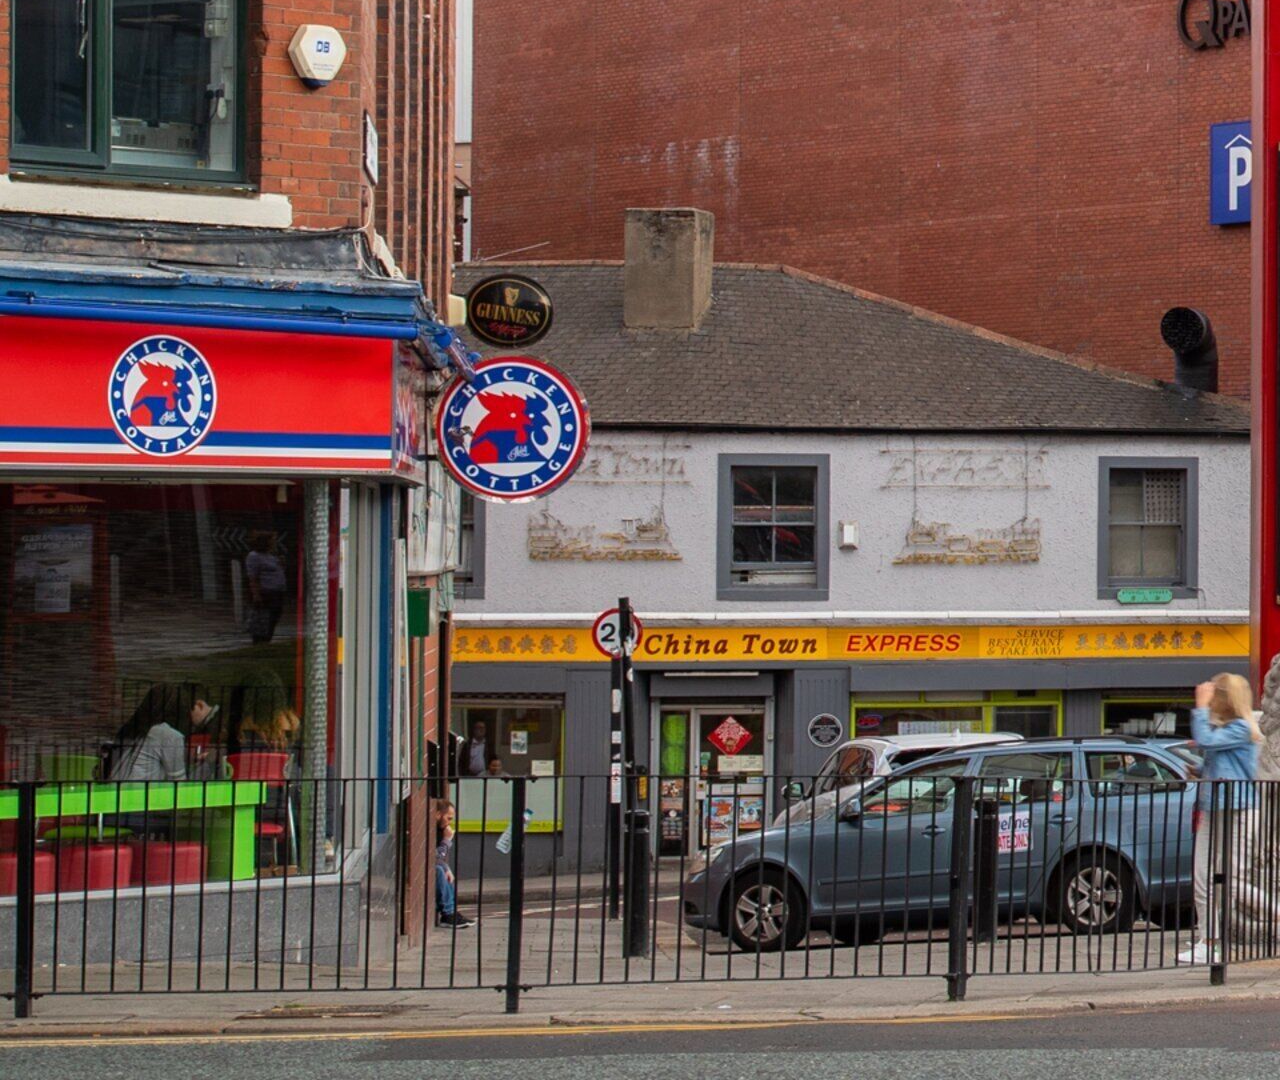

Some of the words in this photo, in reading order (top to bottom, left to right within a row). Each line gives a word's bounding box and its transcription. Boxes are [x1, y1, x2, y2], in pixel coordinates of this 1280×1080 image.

[476, 303, 541, 325] GUINNESS
[116, 340, 211, 386] CHICKEN
[450, 368, 572, 417] CHICKEN
[116, 409, 209, 452] COTTAGE
[452, 443, 572, 490] COTTAGE
[846, 633, 961, 652] EXPRESS
[988, 638, 1064, 647] RESTAURANT
[1016, 629, 1065, 638] SERVICE
[644, 635, 729, 655] China
[742, 634, 819, 654] Town
[1000, 646, 1029, 656] TAKE
[1032, 646, 1064, 656] AWAY
